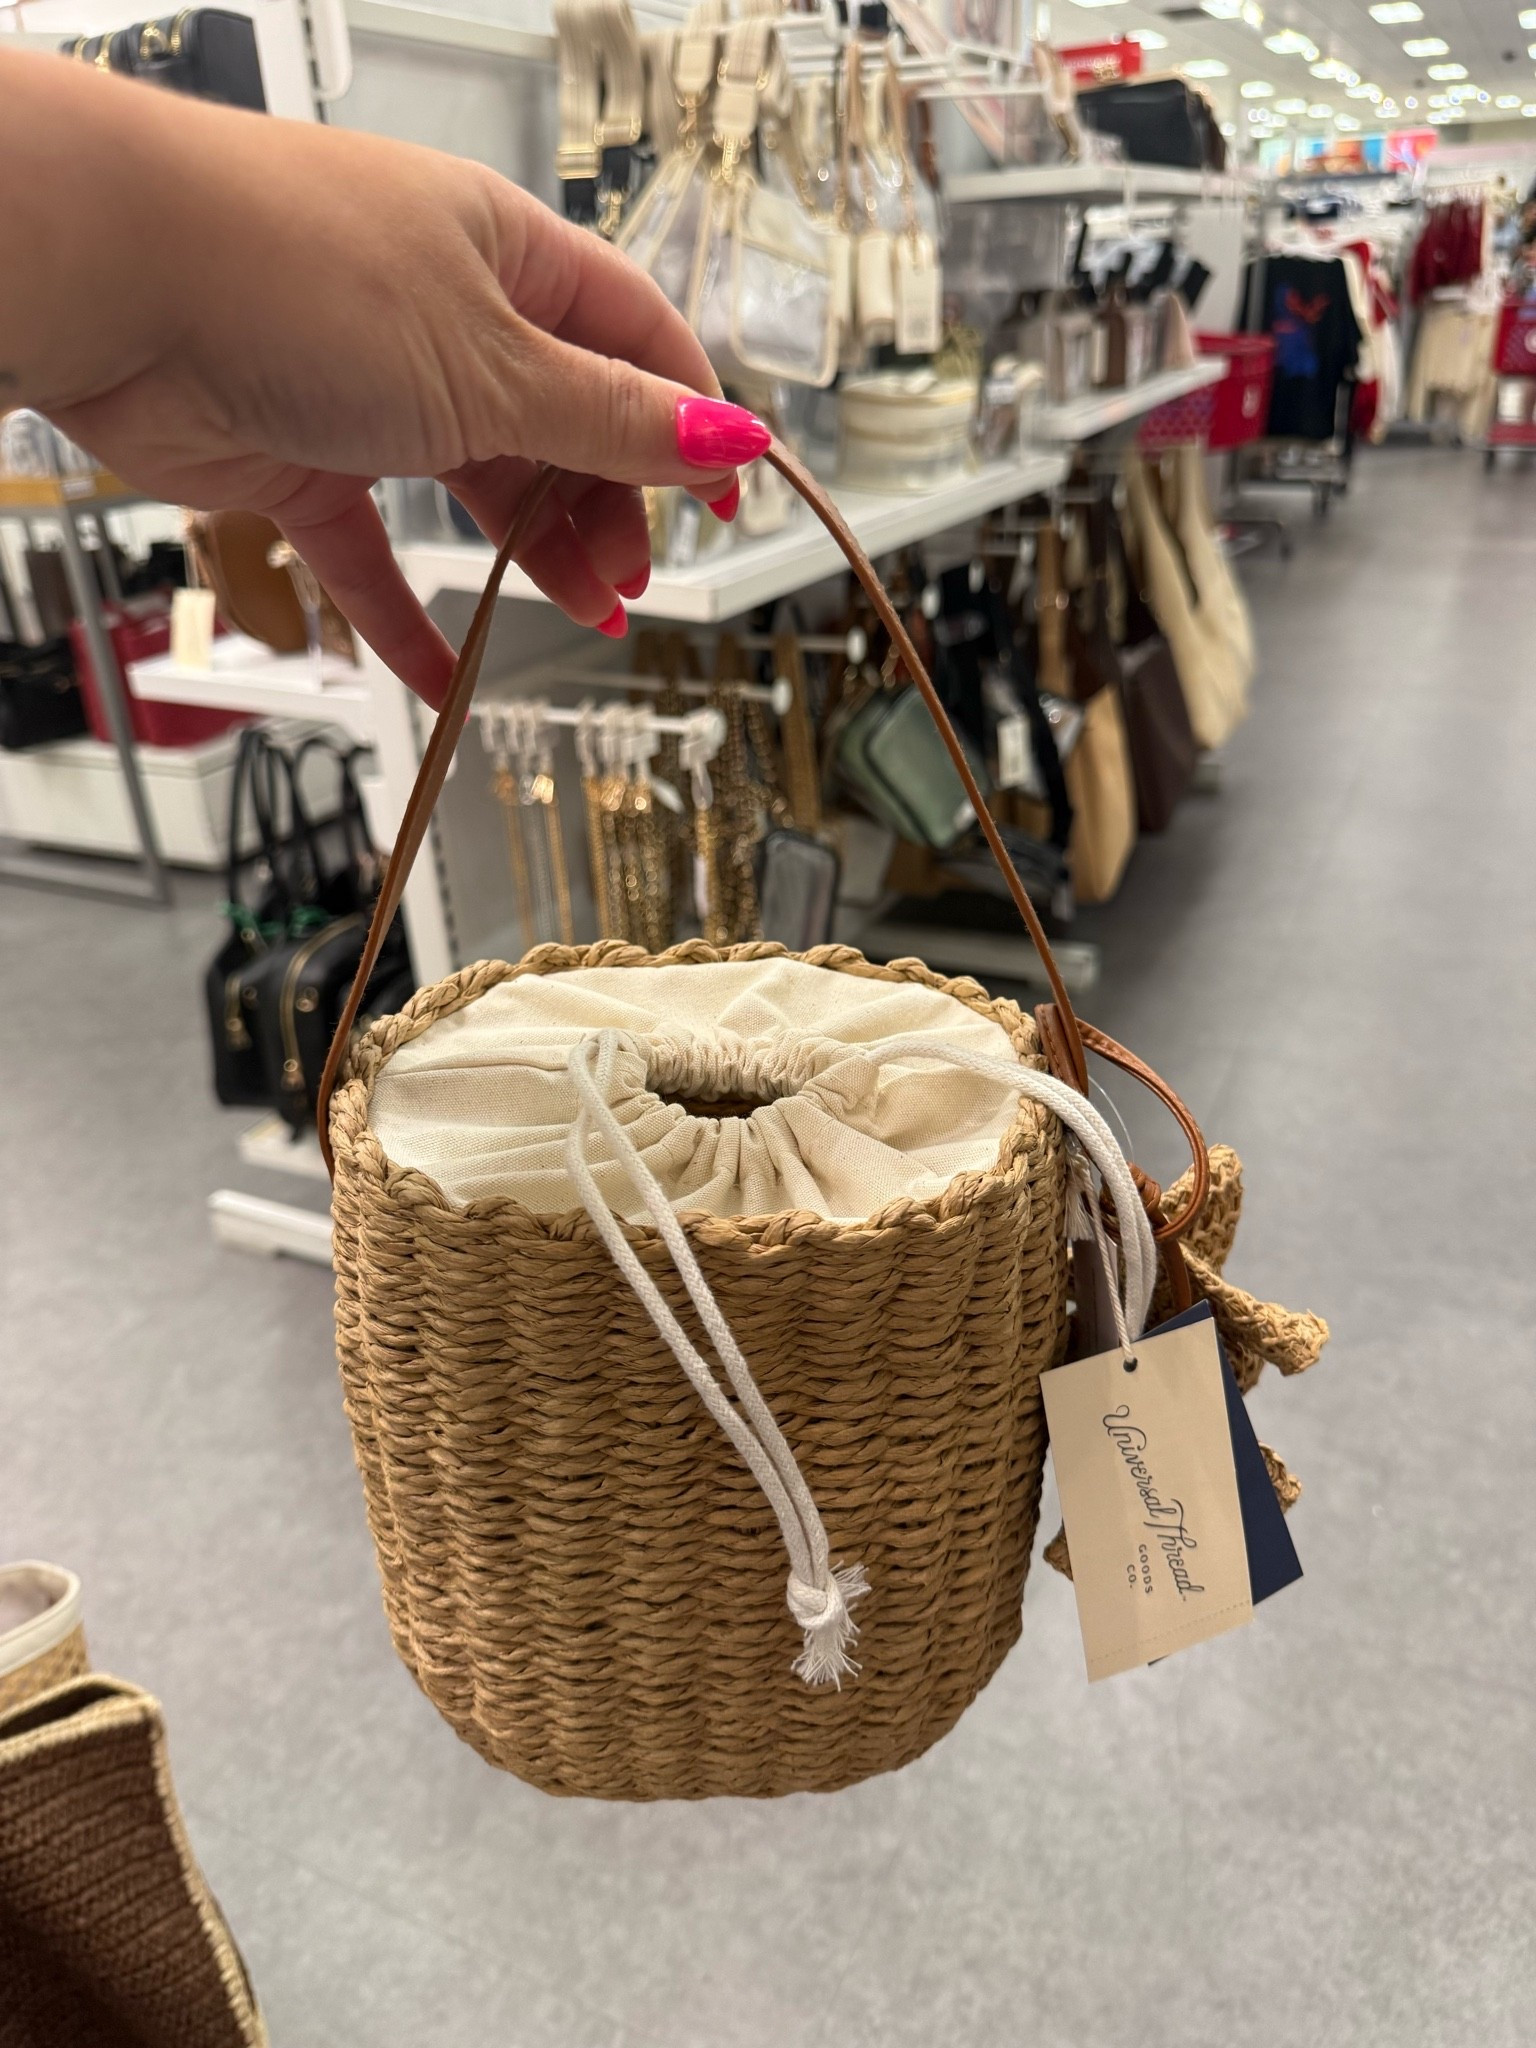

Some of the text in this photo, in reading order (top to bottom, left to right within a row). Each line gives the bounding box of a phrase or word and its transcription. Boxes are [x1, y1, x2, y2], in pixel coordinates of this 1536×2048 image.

[1102, 1404, 1205, 1596] Universal Thread
[1126, 1563, 1137, 1589] CO.
[1138, 1544, 1153, 1594] GOODS
